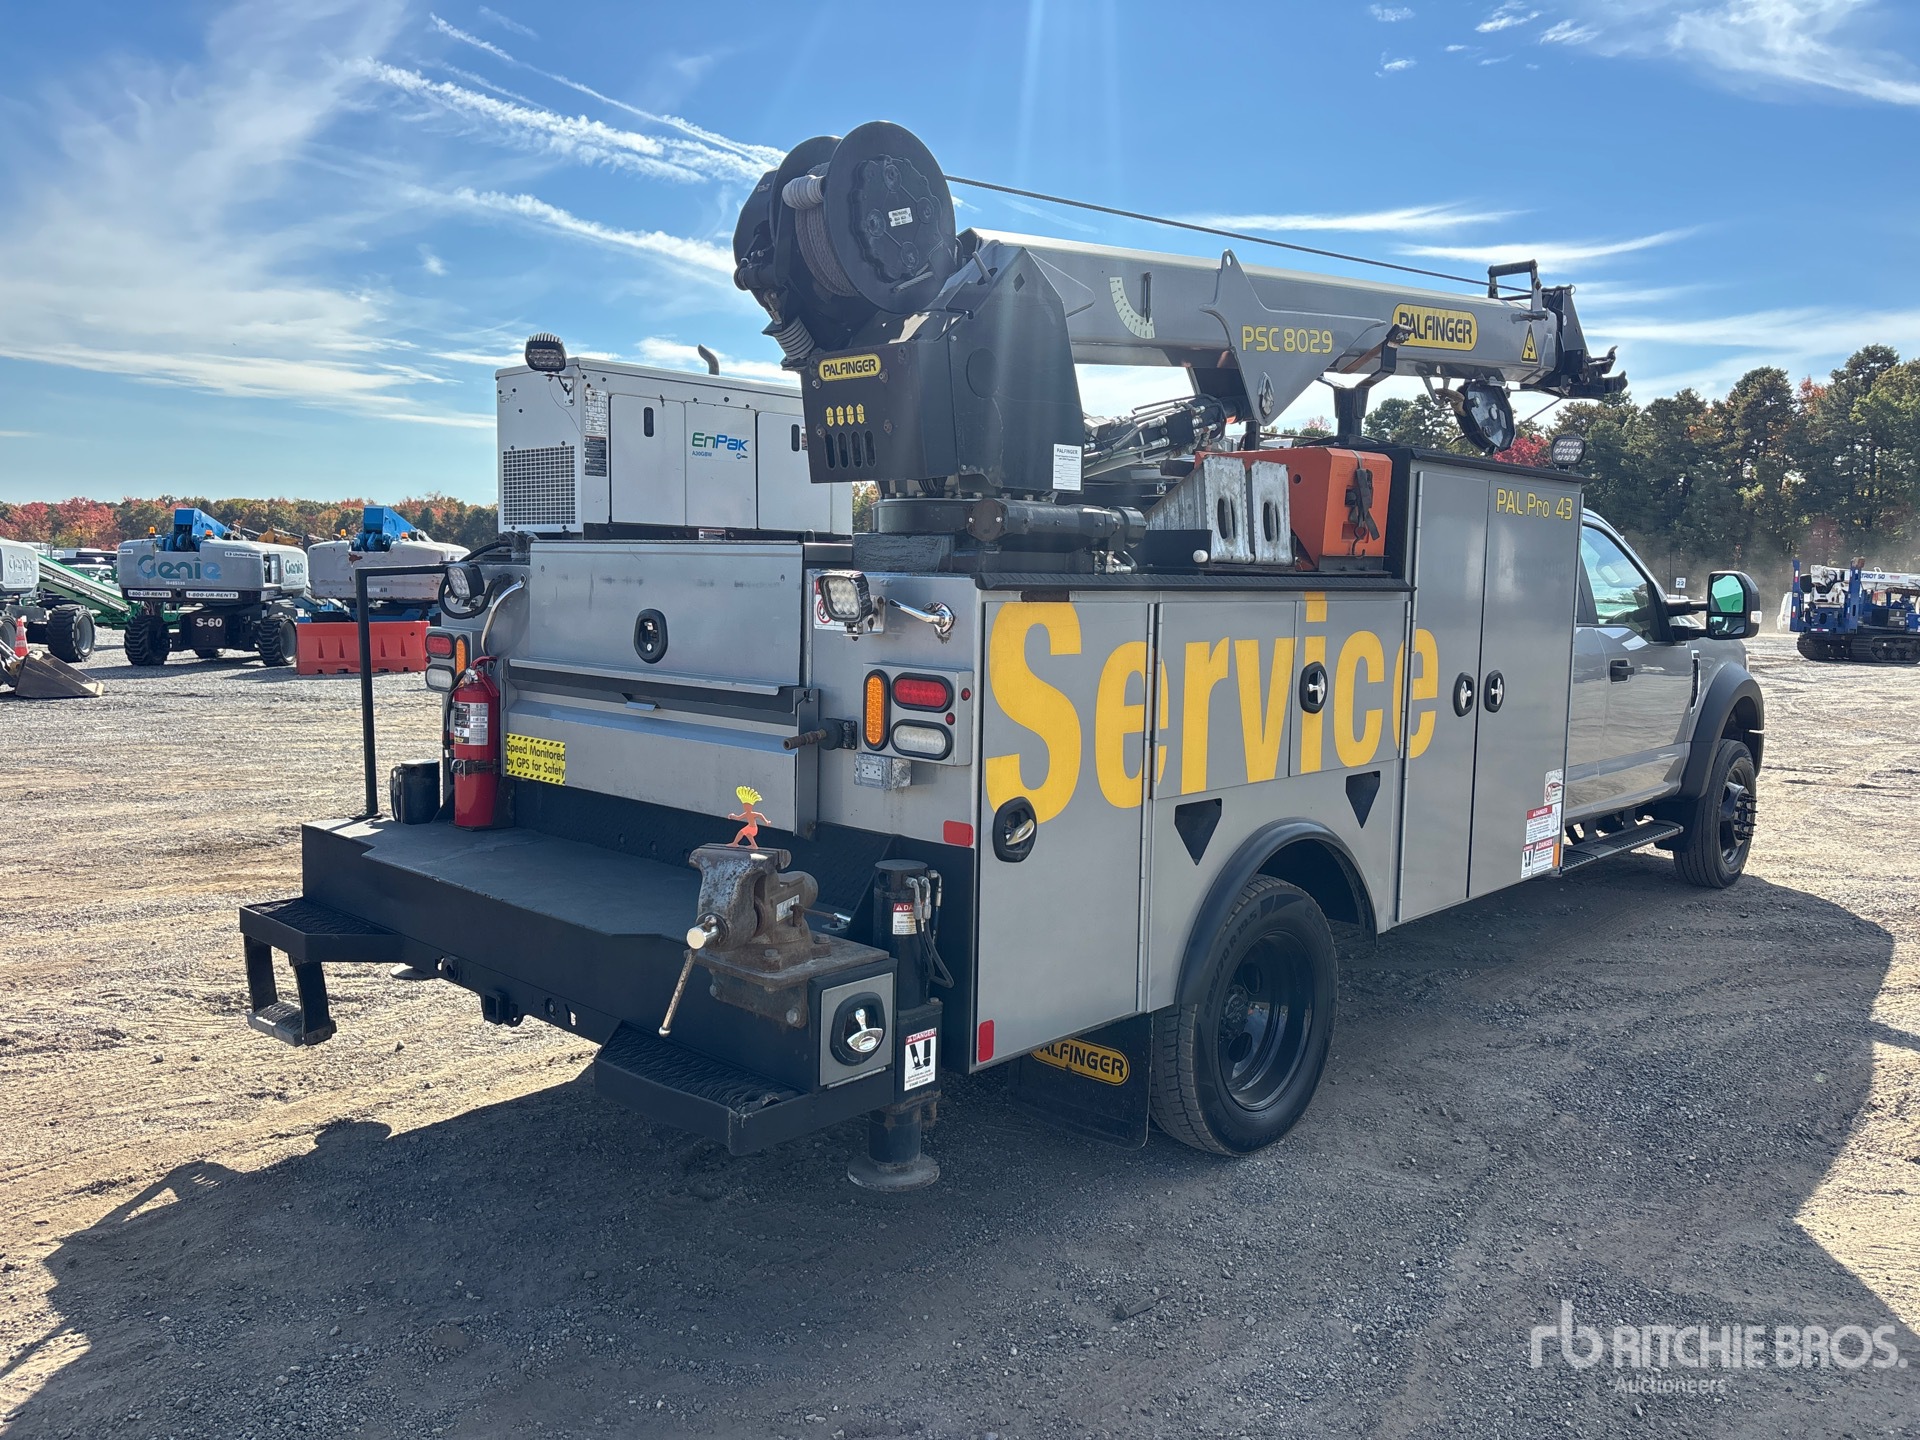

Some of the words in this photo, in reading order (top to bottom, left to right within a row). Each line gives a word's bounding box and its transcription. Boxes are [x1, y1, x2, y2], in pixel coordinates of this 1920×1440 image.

[1398, 311, 1473, 344] PALFINGER
[1241, 325, 1280, 352] PSC
[1283, 328, 1333, 354] 8029
[822, 358, 877, 378] PALFINGER
[691, 432, 749, 452] EnPak
[1056, 447, 1078, 455] PALFINGER
[1496, 488, 1524, 515] PAL
[1527, 492, 1550, 518] Pro
[1555, 496, 1573, 521] 43
[137, 554, 223, 580] Genie
[285, 559, 304, 575] Genie
[195, 617, 223, 628] S-60
[986, 592, 1439, 825] Service
[507, 741, 528, 755] Speed
[529, 745, 566, 762] Monitored
[516, 757, 530, 770] GPS
[531, 759, 542, 772] for
[543, 761, 566, 780] Safety
[913, 1030, 935, 1041] DANGER
[1040, 1043, 1124, 1077] ALFINGER
